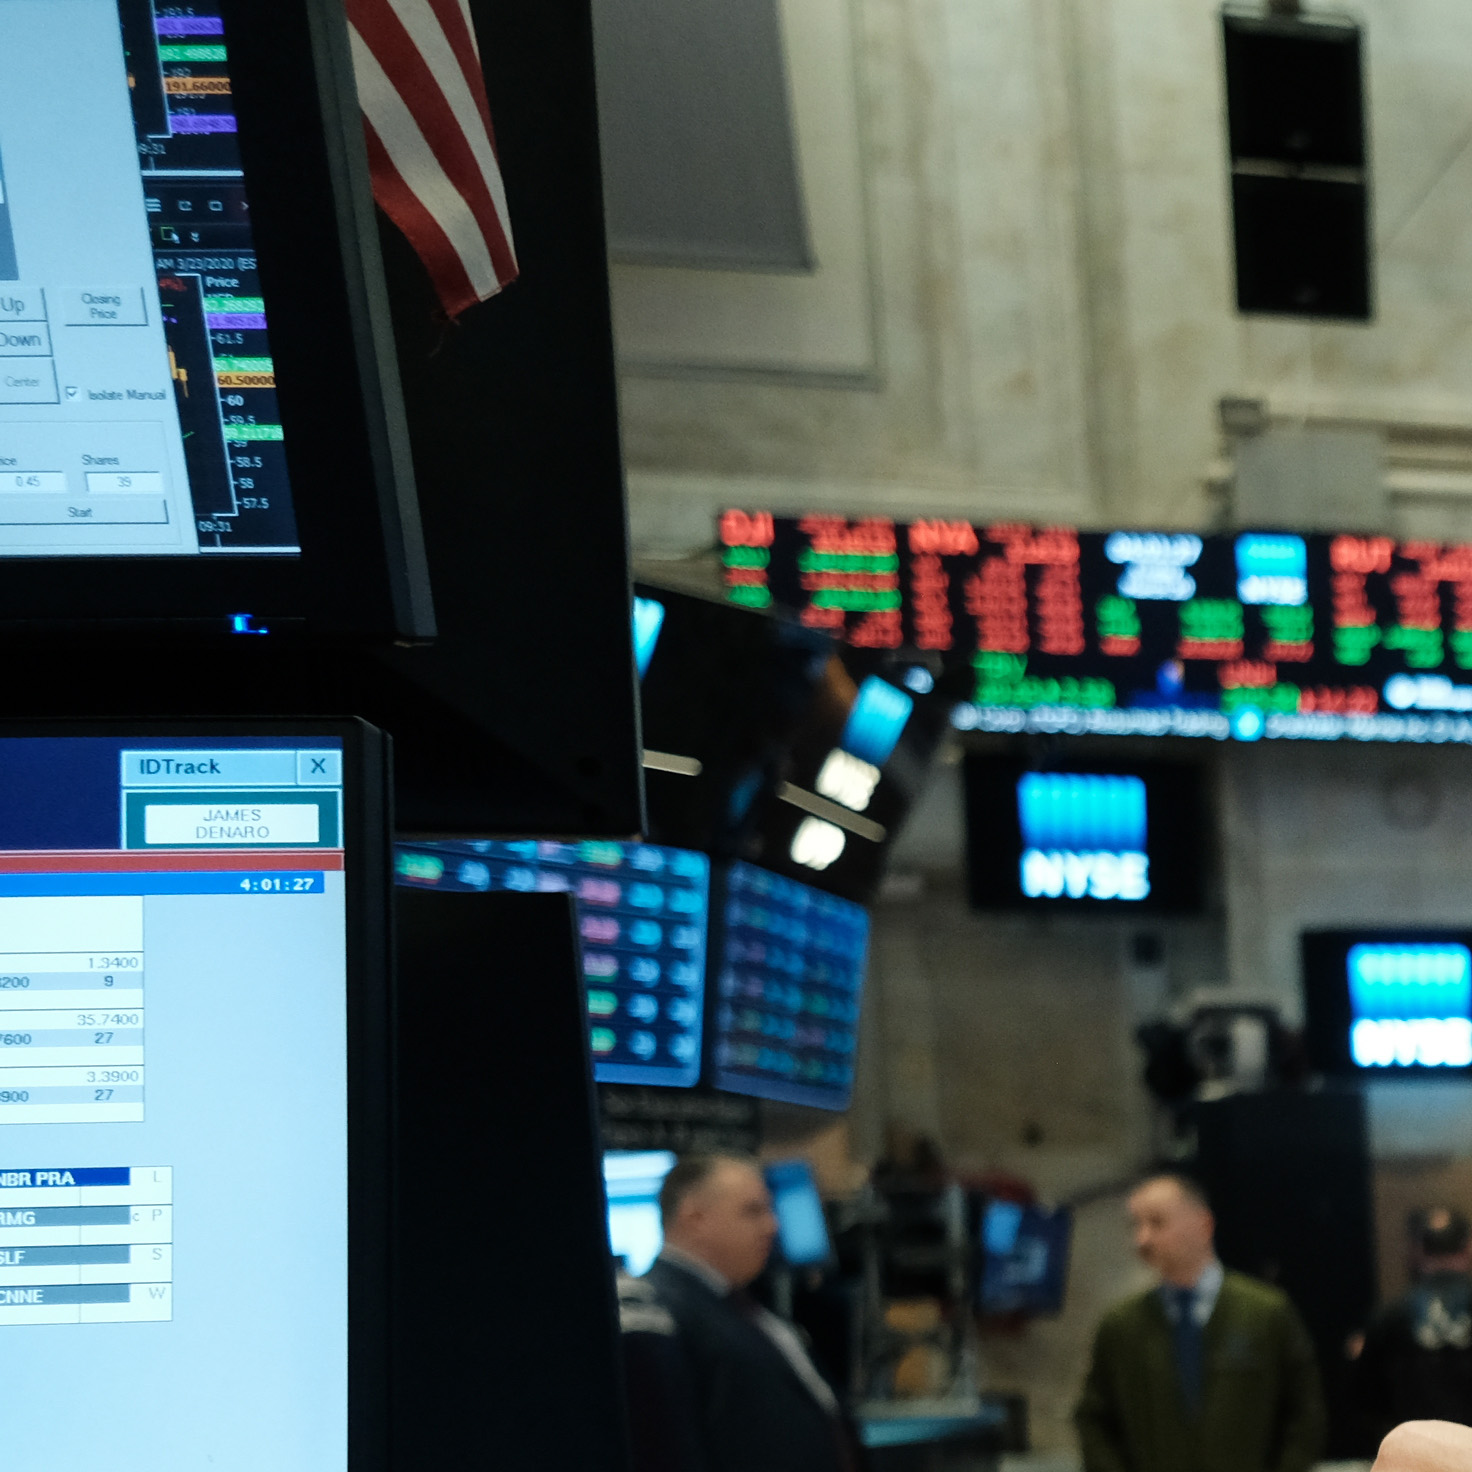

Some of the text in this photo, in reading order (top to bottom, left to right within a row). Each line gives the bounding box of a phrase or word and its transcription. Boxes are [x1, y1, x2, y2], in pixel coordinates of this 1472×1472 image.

[205, 274, 240, 288] Price
[1, 297, 25, 315] Up
[81, 292, 121, 308] Closing
[90, 307, 117, 320] Price
[0, 332, 42, 348] Down
[88, 389, 167, 401] Isolate Manual
[81, 454, 120, 467] Shares
[235, 456, 263, 468] 58.5
[238, 477, 255, 490] 58
[242, 497, 270, 510] 57.5
[67, 506, 93, 519] Start
[140, 758, 222, 775] IDTrack
[203, 808, 262, 822] JAMES
[195, 825, 270, 839] DENARO
[1021, 848, 1151, 901] NYSE
[239, 877, 315, 892] 4:01:27
[103, 975, 114, 988] 9
[76, 1013, 139, 1026] 35.7400
[94, 1032, 114, 1045] 27
[86, 1070, 139, 1083] 3.3900
[94, 1088, 114, 1102] 27
[35, 1170, 76, 1186] PRA
[0, 1210, 36, 1226] RMG
[151, 1208, 163, 1222] P
[151, 1247, 163, 1261] S
[148, 1286, 166, 1300] W
